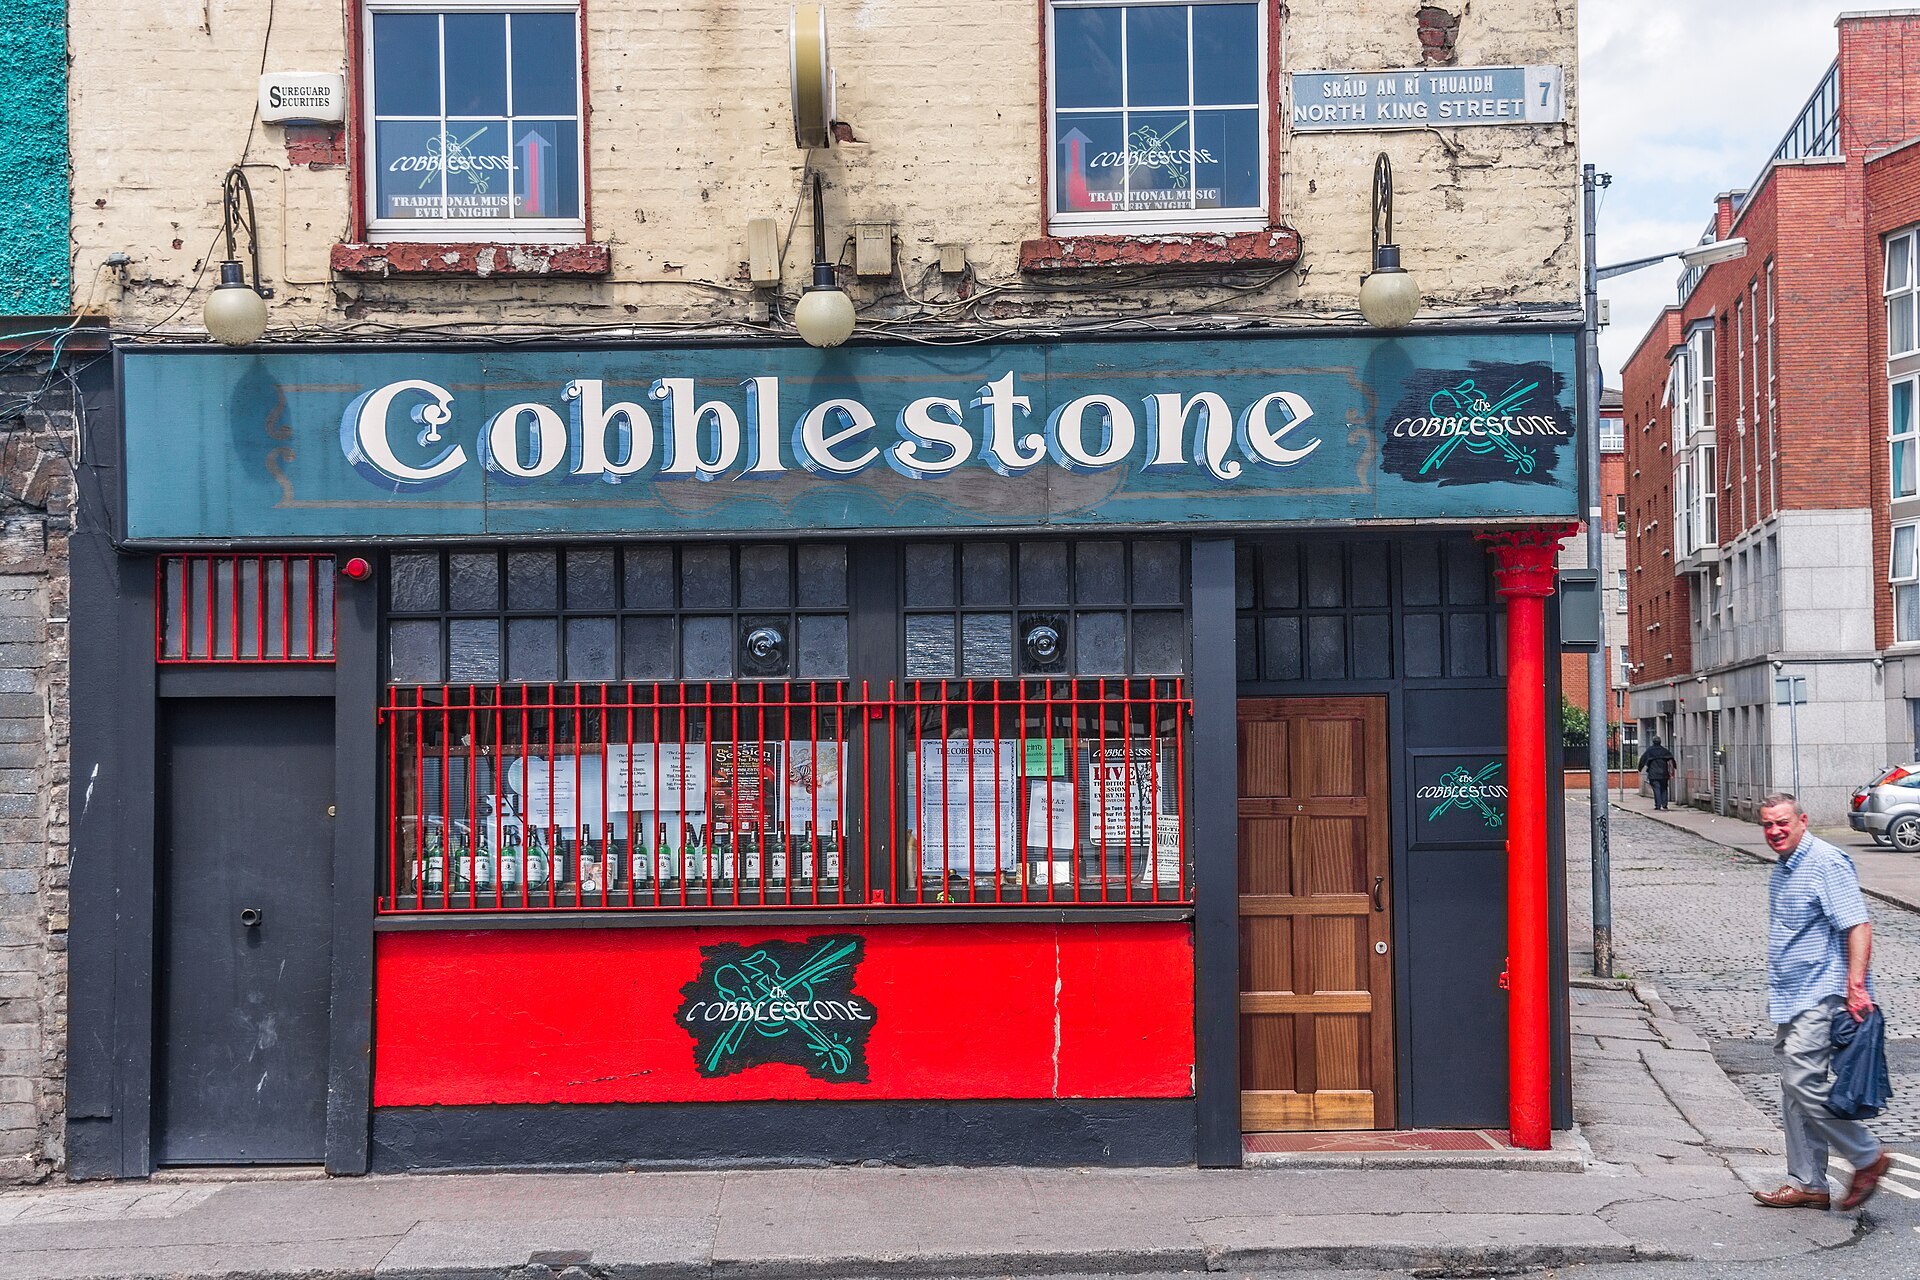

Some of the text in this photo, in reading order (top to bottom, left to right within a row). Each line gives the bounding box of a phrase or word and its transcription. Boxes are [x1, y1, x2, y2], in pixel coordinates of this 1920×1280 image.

[270, 86, 331, 98] SUREGUARD
[1323, 73, 1493, 98] SRÁID AN RÍ THUAIDH
[1538, 82, 1551, 107] 7
[1294, 99, 1523, 122] NORTH KING STREET
[392, 196, 521, 206] TRADITONAL MUSC
[1088, 190, 1174, 203] TRADTIONAL
[459, 207, 499, 217] NIGHT
[1473, 399, 1491, 412] the
[343, 371, 1322, 486] Cobblestone
[1393, 415, 1567, 437] COBBLESTONE
[950, 747, 1000, 755] COBBESTON
[1416, 785, 1508, 799] COBBLESTON
[769, 986, 788, 999] the
[685, 1000, 871, 1022] COBBLESTONE
